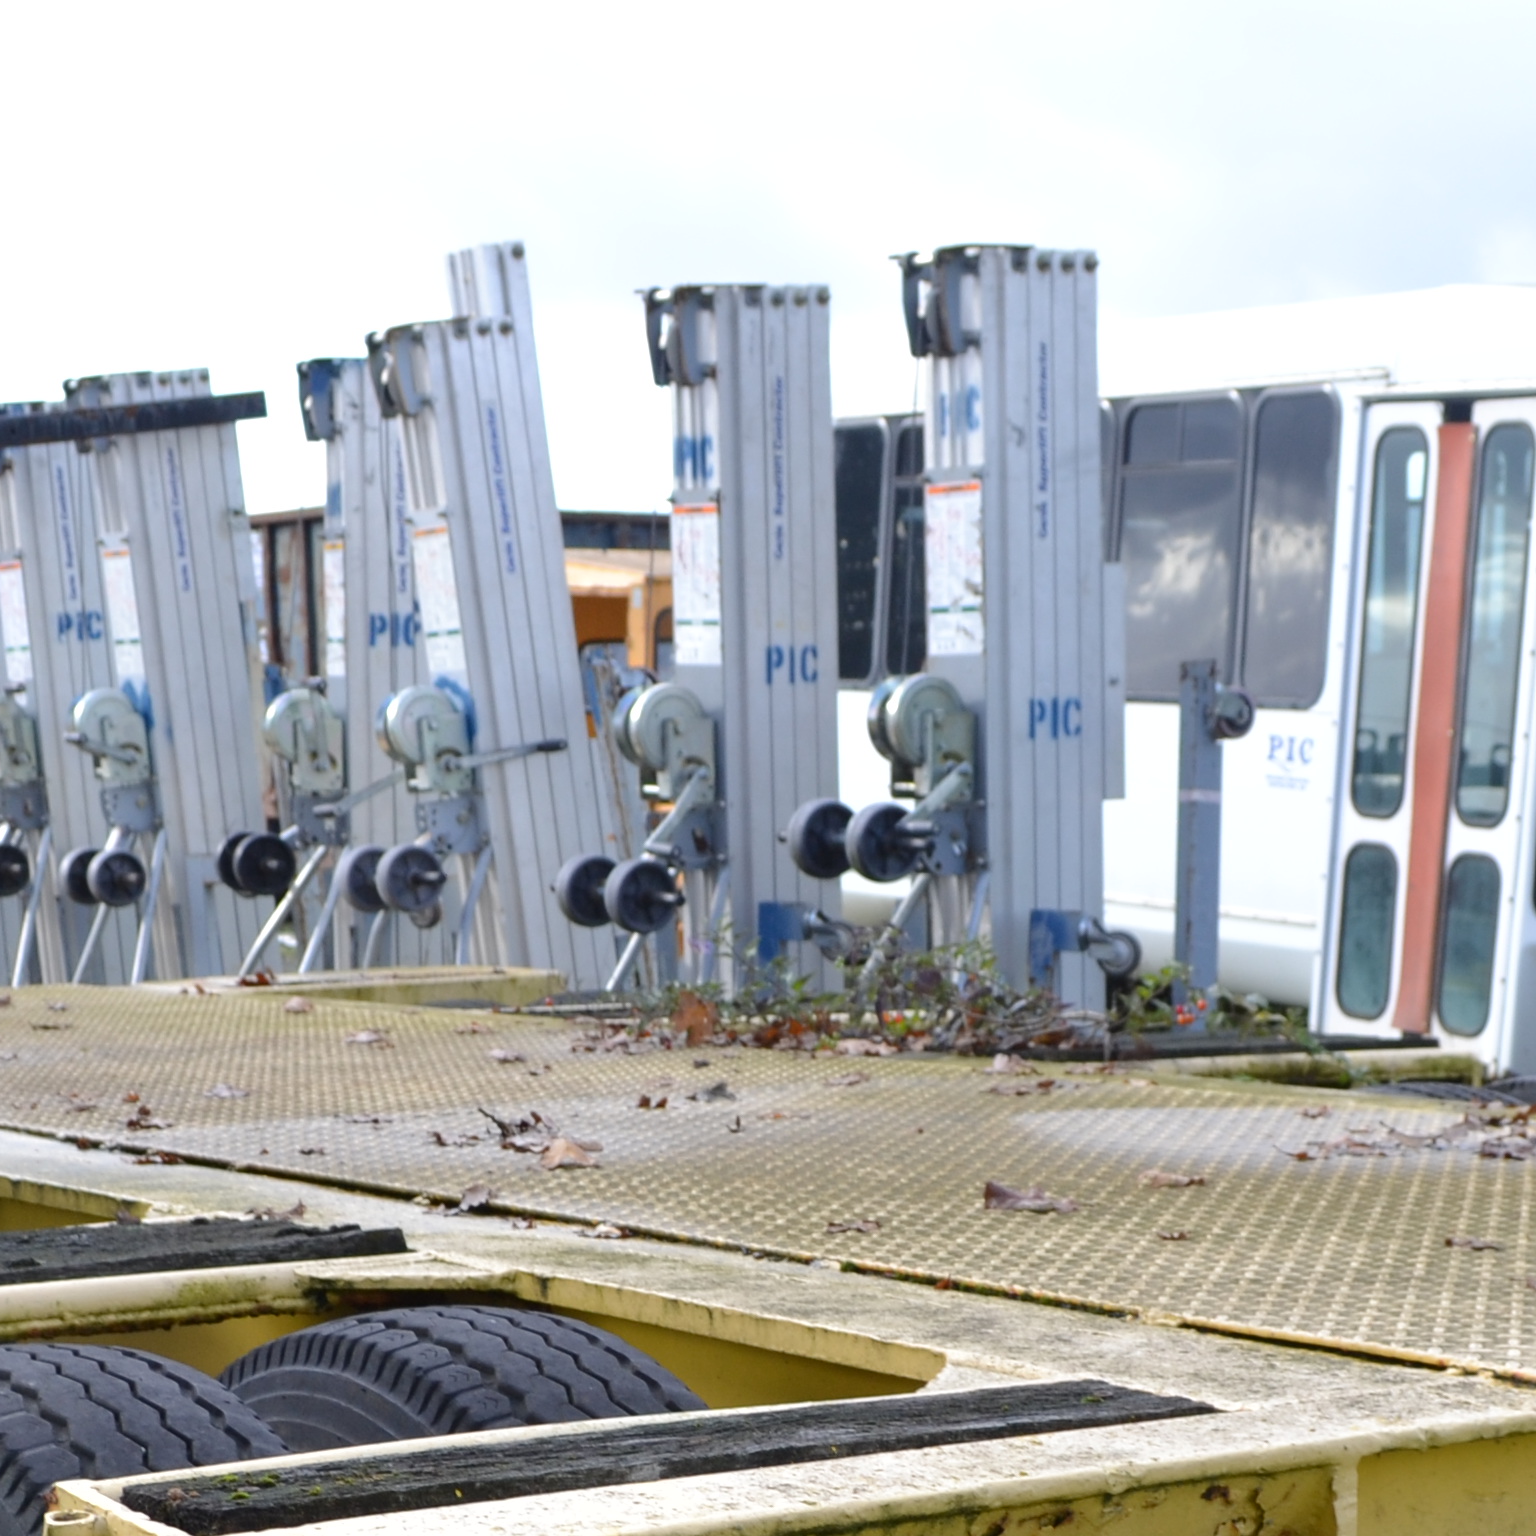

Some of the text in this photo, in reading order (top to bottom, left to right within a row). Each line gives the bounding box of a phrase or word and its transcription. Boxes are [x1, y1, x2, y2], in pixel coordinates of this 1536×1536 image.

[57, 611, 103, 641] PIC
[765, 645, 818, 684] PIC
[1027, 695, 1083, 741] PIC
[1267, 735, 1314, 765] PIC
